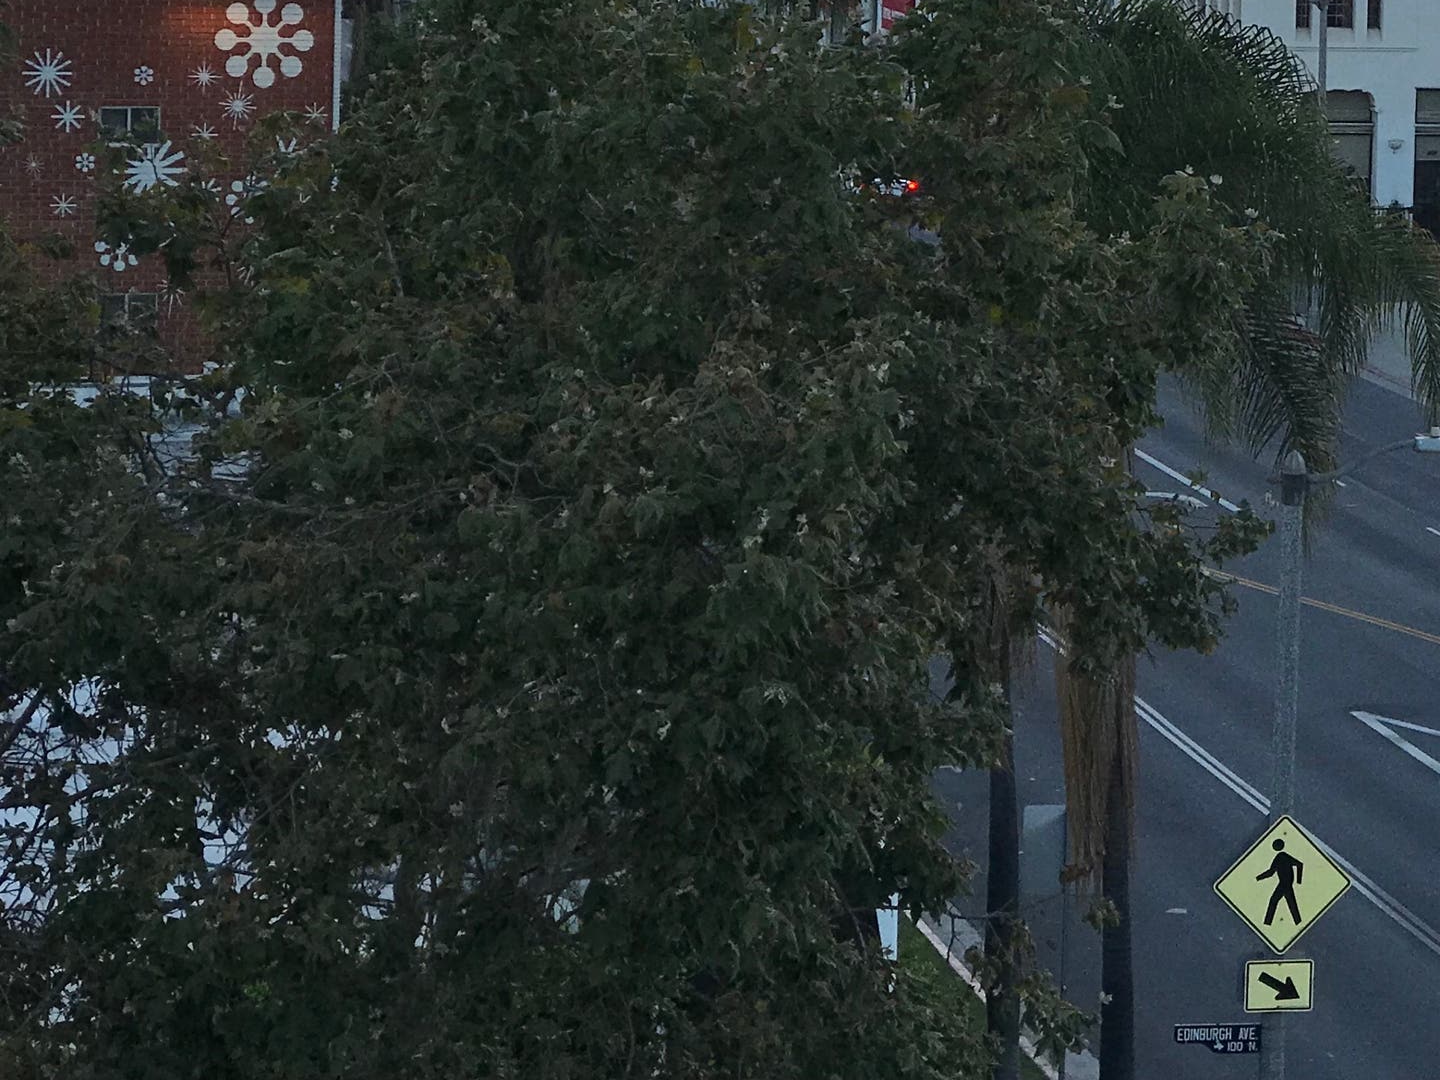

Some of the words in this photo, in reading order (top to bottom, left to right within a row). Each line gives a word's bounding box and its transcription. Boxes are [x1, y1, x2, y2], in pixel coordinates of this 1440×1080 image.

[1177, 1027, 1232, 1041] EDINBURGH
[1238, 1027, 1258, 1040] AVE.
[1227, 1041, 1244, 1052] 100
